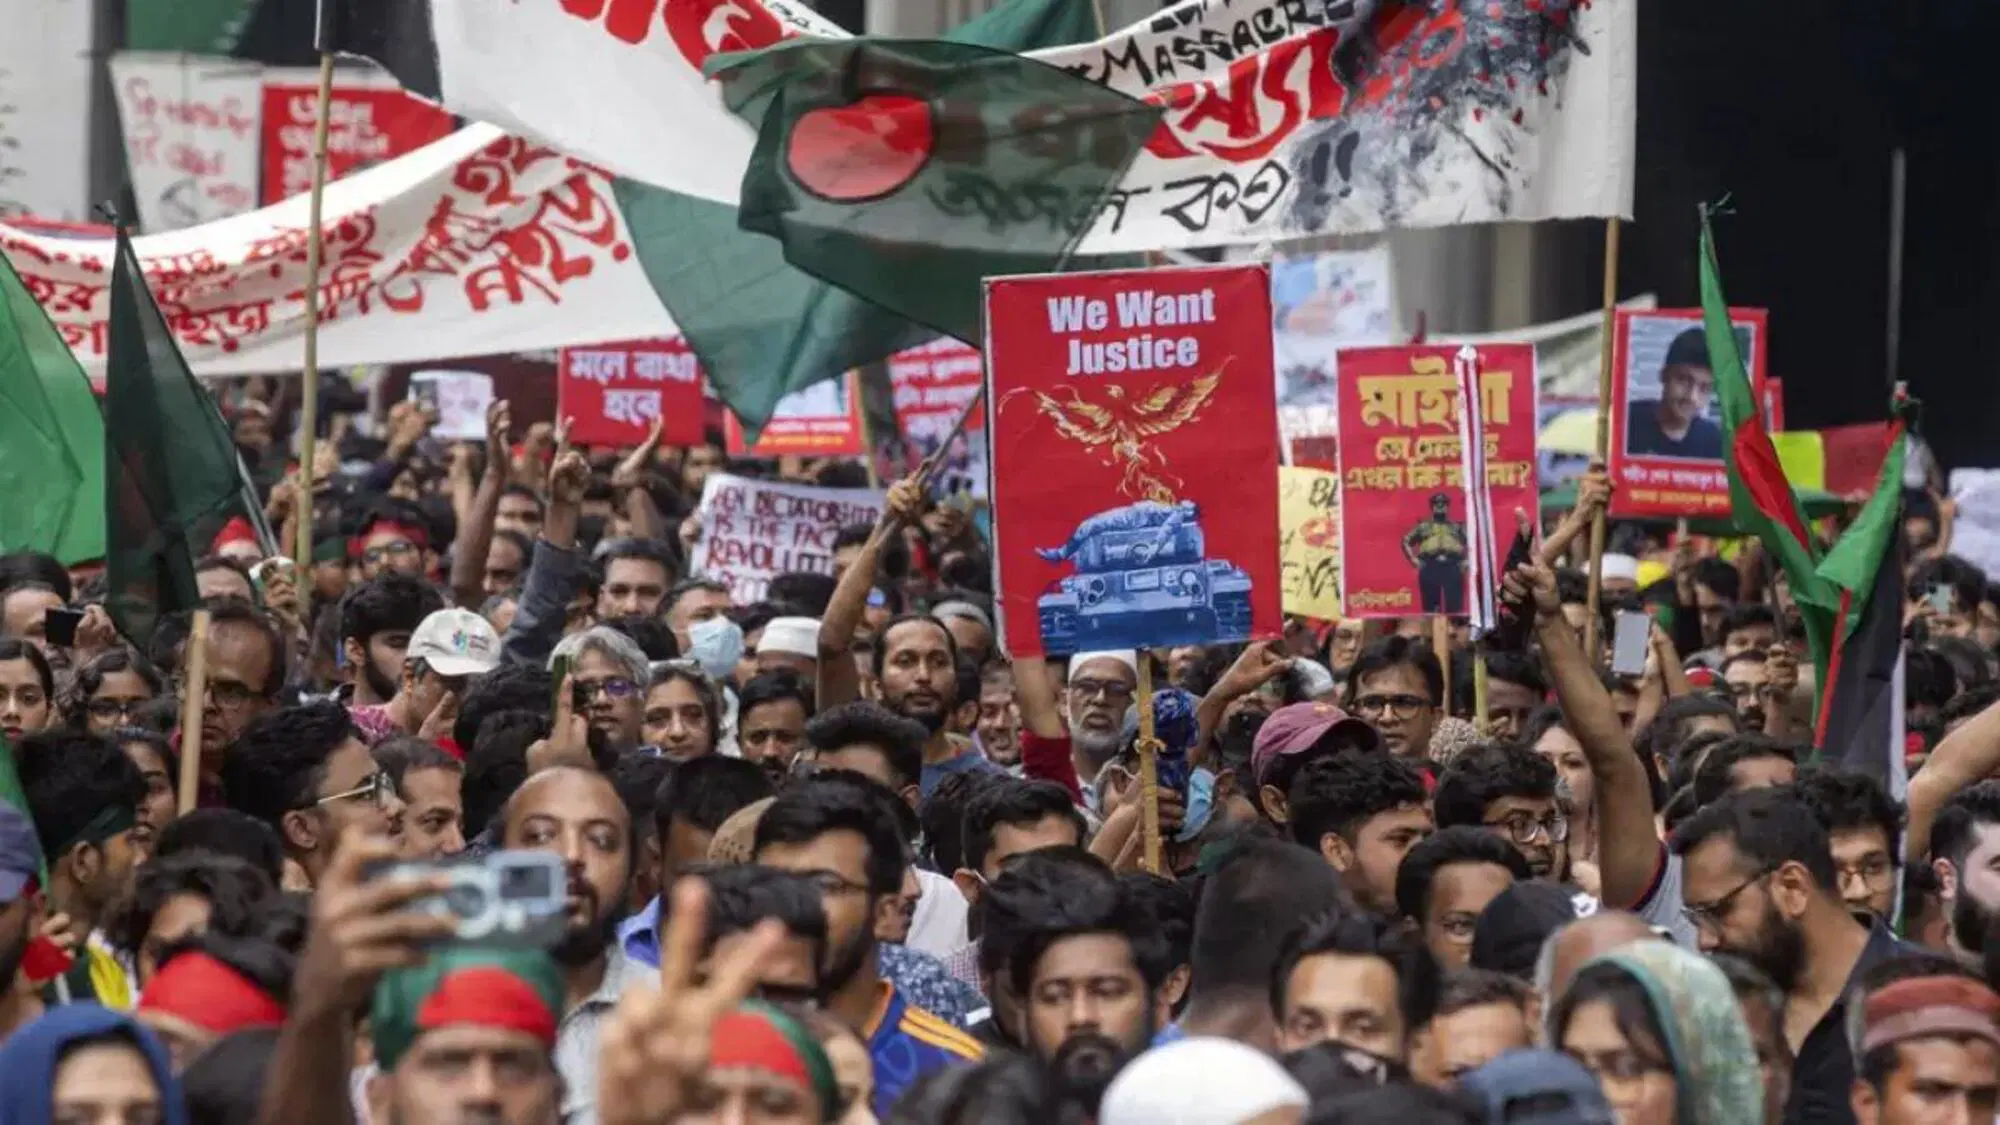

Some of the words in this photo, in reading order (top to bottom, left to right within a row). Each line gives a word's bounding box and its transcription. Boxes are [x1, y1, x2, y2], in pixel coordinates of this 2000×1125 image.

[1047, 296, 1109, 332] We
[1116, 289, 1216, 329] Want
[1067, 335, 1199, 375] Justice
[1355, 355, 1513, 431] মাইা
